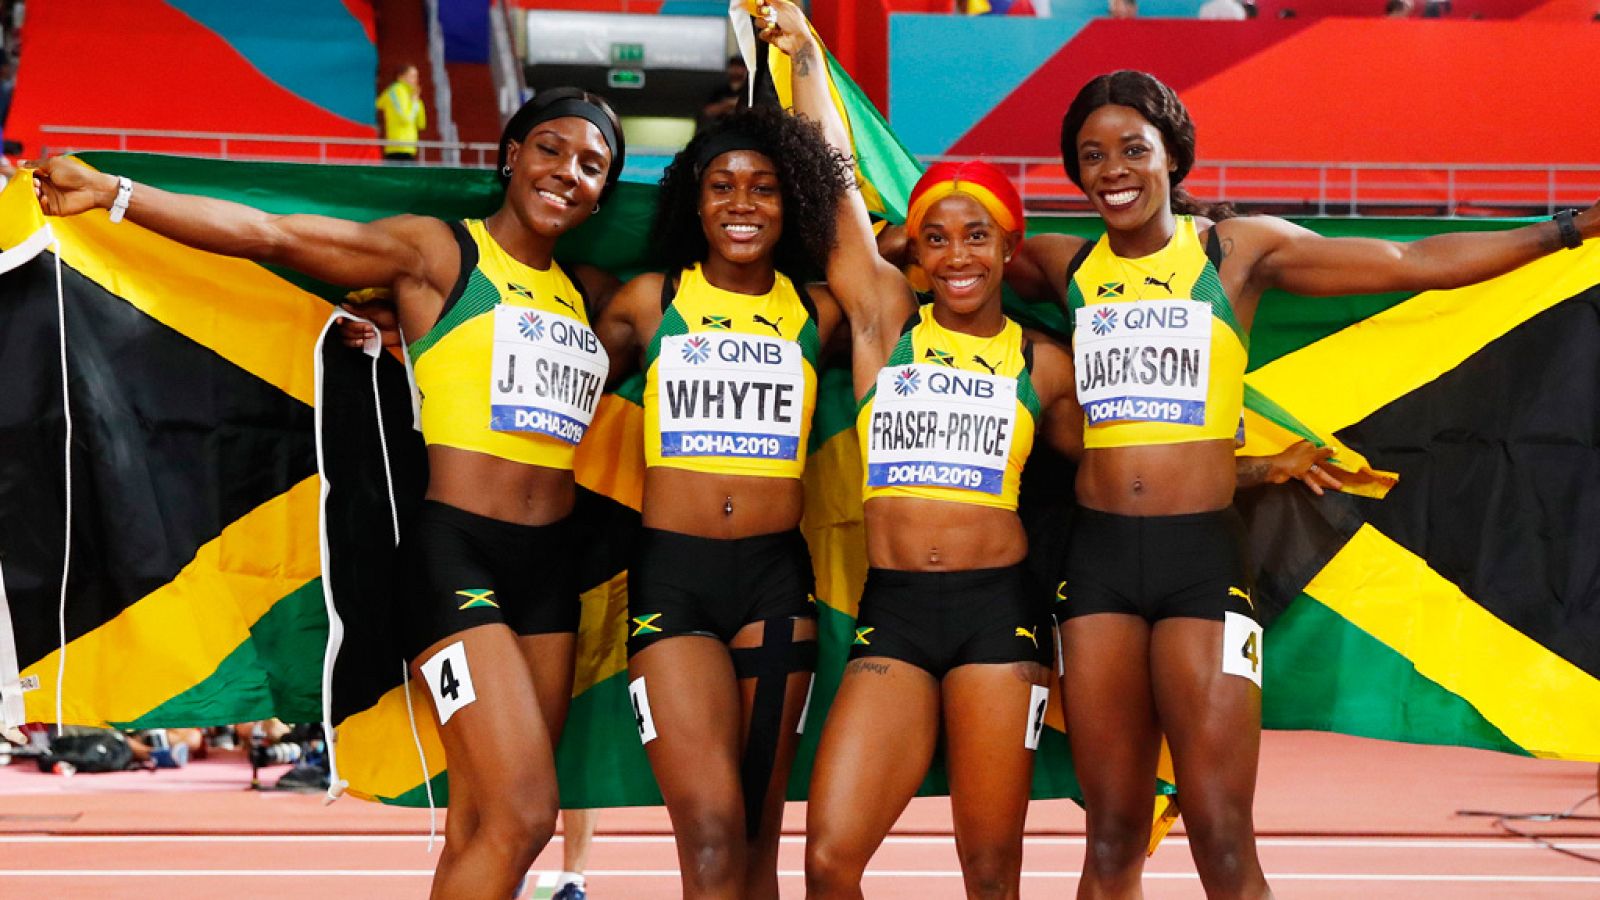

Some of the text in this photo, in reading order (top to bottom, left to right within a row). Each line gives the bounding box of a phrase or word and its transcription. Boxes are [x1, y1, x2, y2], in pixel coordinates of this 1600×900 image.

[1124, 307, 1188, 330] QNB
[550, 321, 598, 354] QNB
[718, 339, 782, 365] QNB
[498, 354, 600, 414] J. SMITH
[928, 372, 994, 399] QNB
[1080, 346, 1201, 392] JACKSON
[666, 380, 793, 423] WHYTE
[1090, 398, 1182, 421] DOHA2019
[514, 409, 583, 443] DOHA2019
[871, 410, 1009, 457] FRASER-PRYCE
[681, 434, 780, 455] DOHA2019
[887, 464, 982, 487] DOHA2019
[1241, 631, 1258, 672] 4
[440, 658, 460, 701] 4
[633, 691, 645, 734] 4
